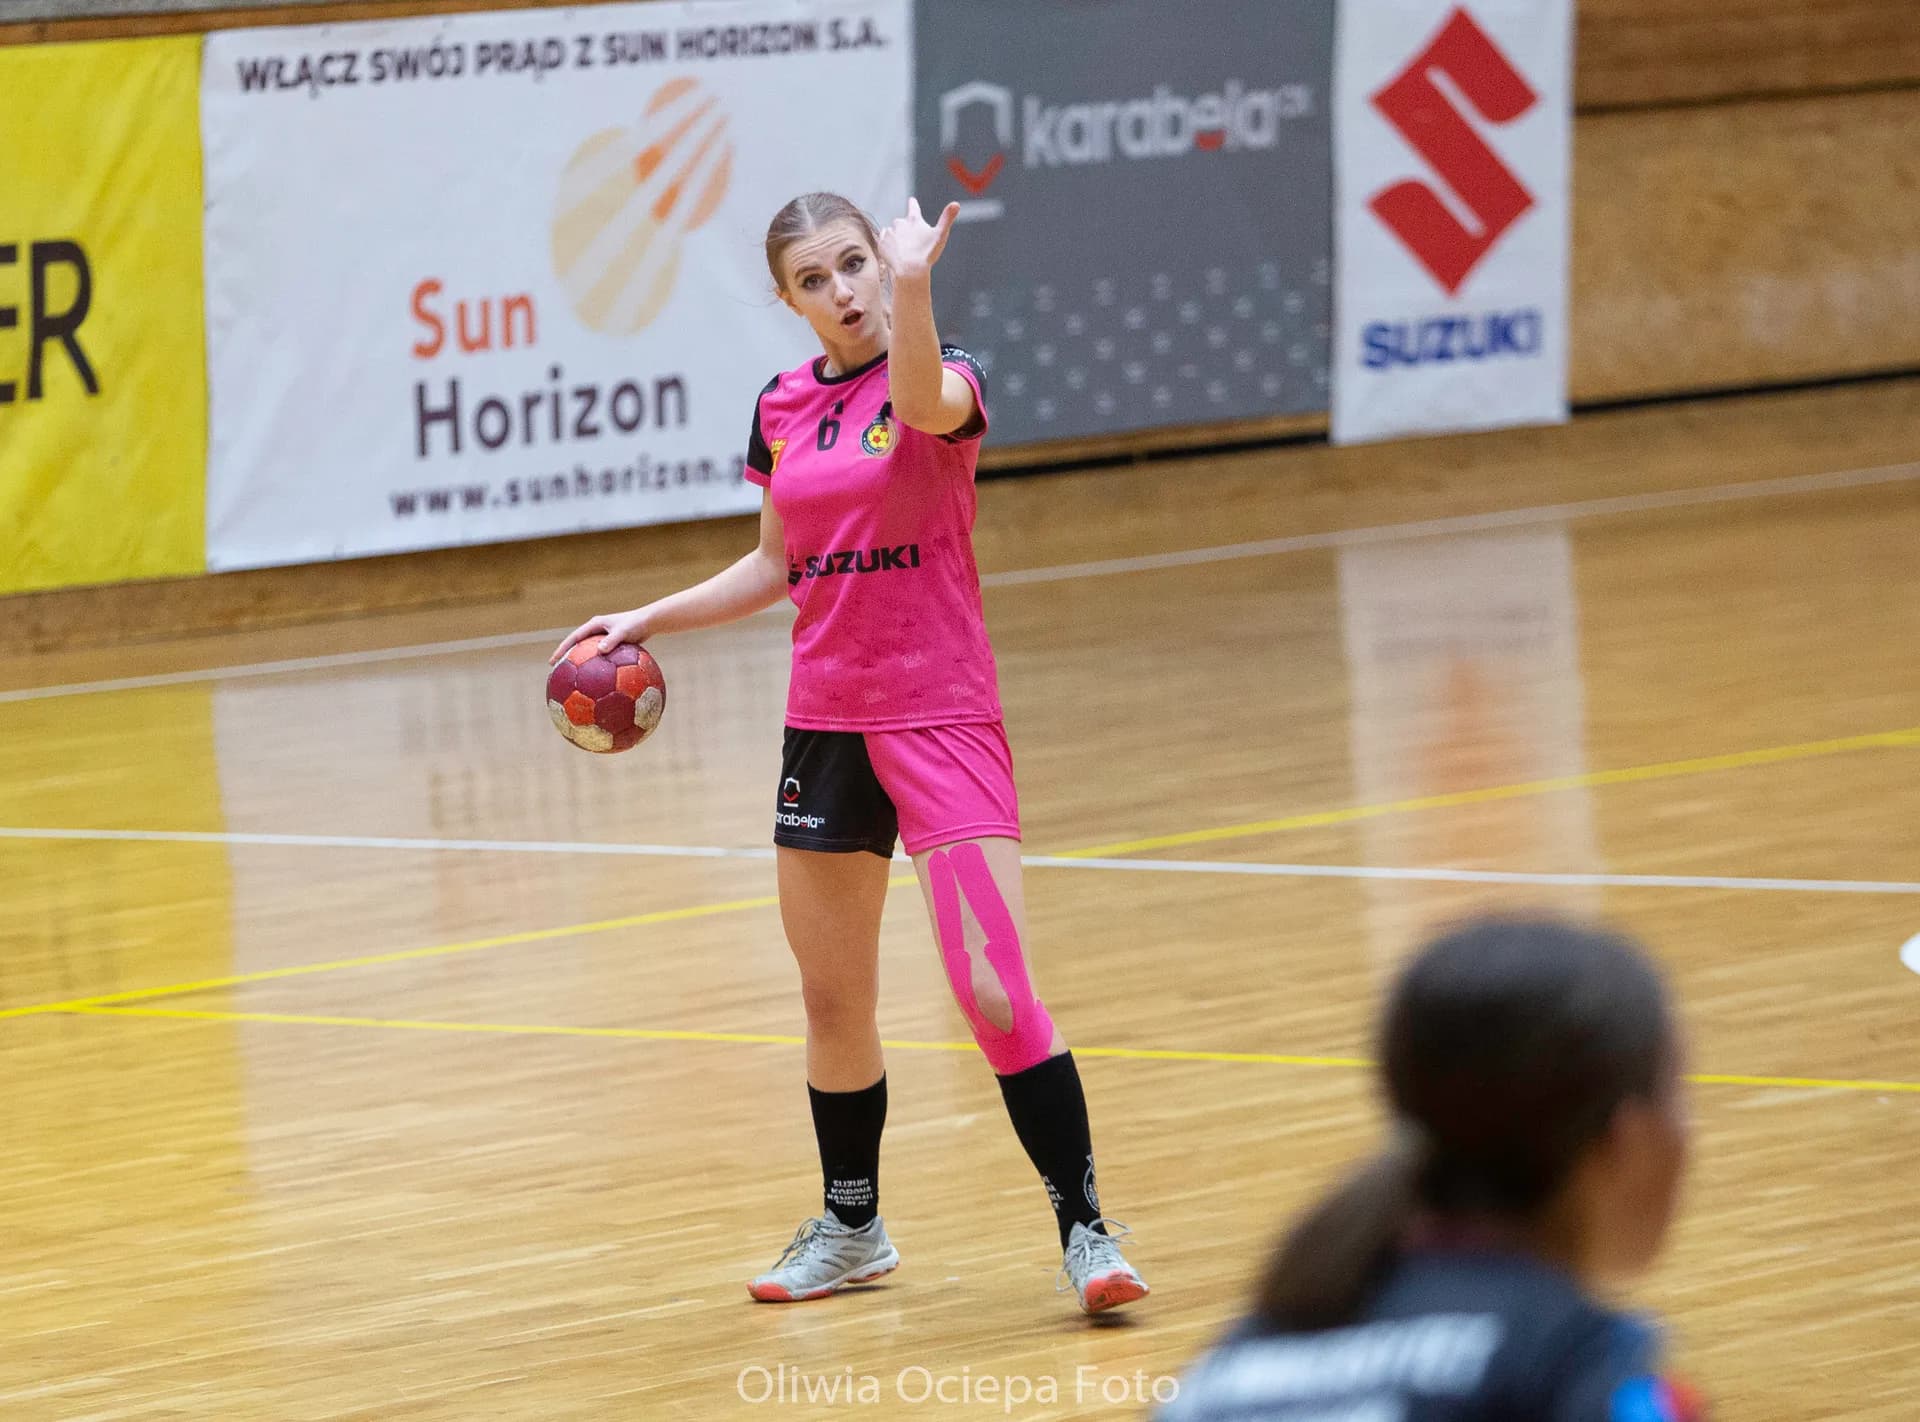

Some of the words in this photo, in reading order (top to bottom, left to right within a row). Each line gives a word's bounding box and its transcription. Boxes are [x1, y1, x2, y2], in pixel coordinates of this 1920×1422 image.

[369, 35, 463, 83] SWÓJ
[474, 38, 565, 82] PRĄD
[575, 33, 595, 67] Z
[604, 29, 667, 65] SUN
[676, 21, 818, 60] HORIZON
[827, 17, 887, 50] S.A.
[1022, 79, 1278, 168] karabela
[411, 279, 536, 358] Sun
[1362, 307, 1541, 370] SUZUKI
[413, 363, 689, 457] Horizon
[816, 399, 843, 451] 6
[805, 544, 920, 578] SUZUKI
[776, 812, 818, 829] arabela
